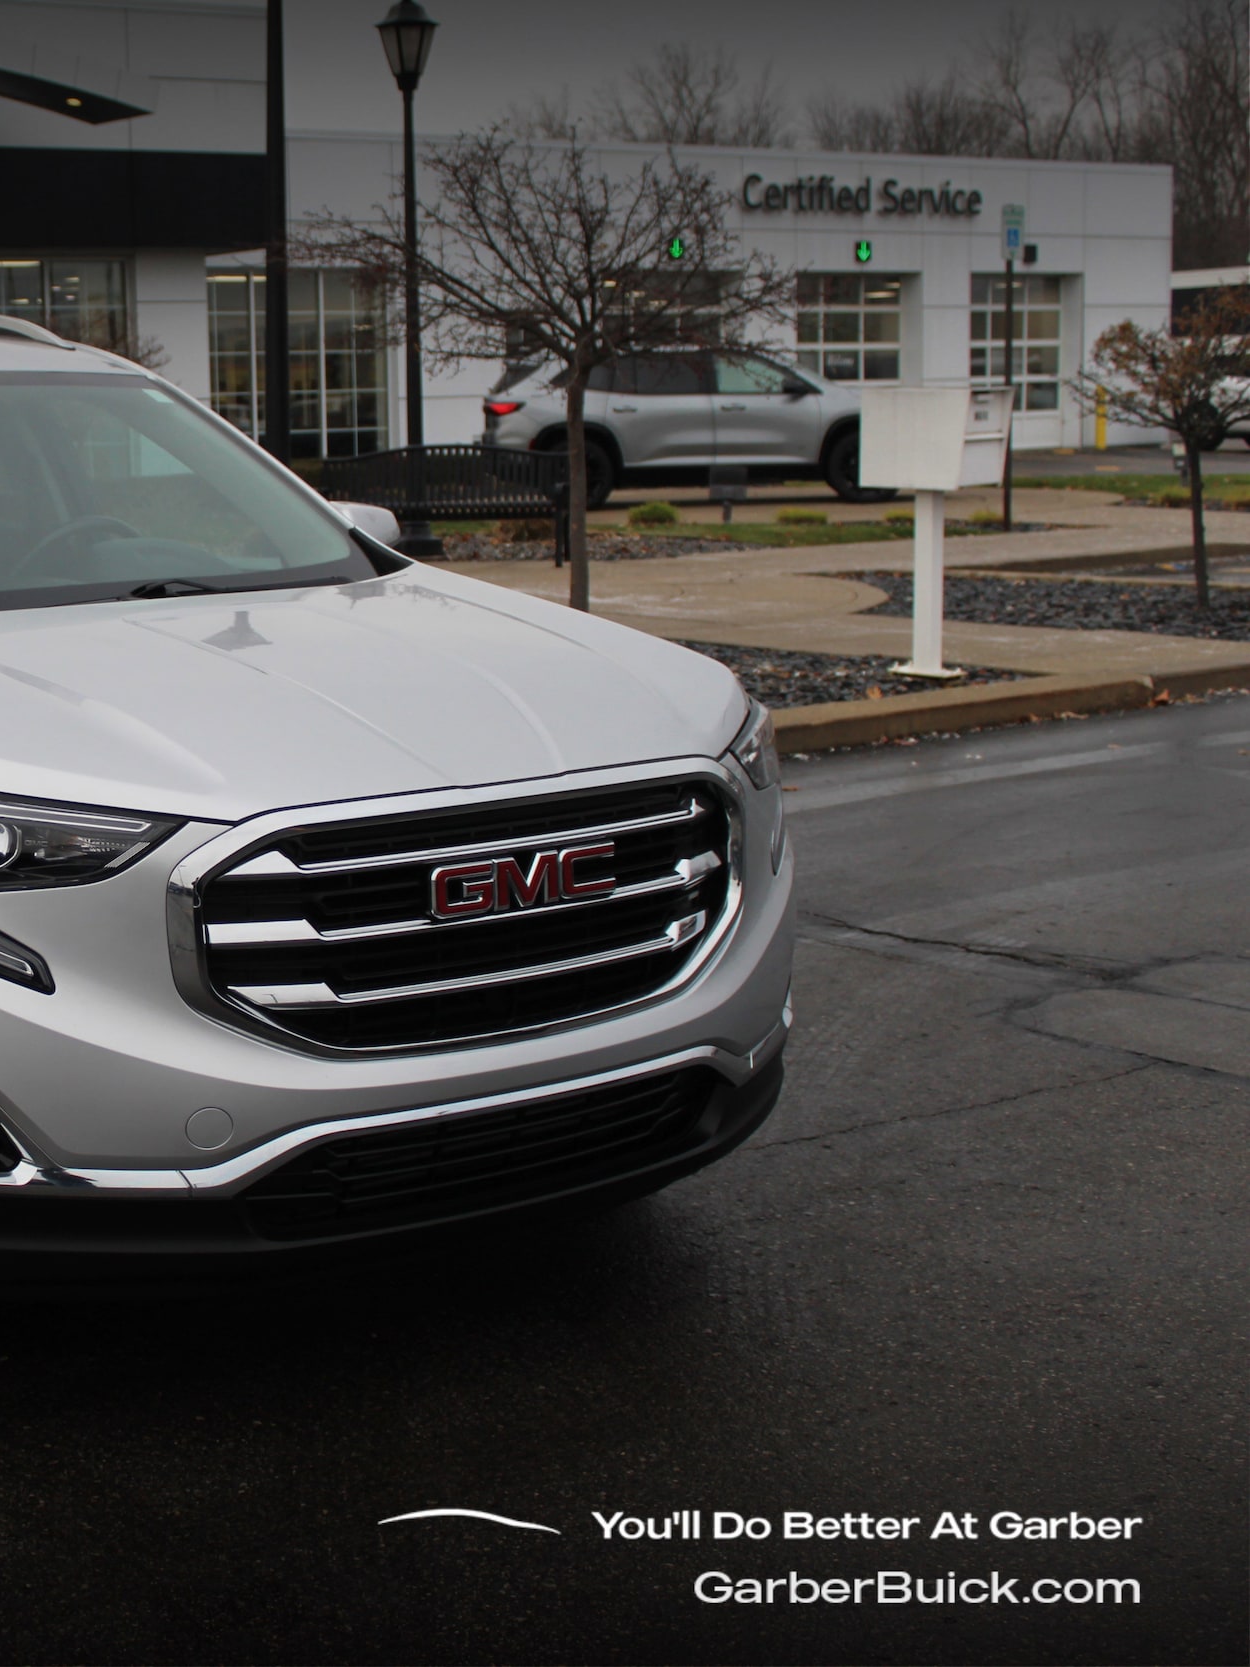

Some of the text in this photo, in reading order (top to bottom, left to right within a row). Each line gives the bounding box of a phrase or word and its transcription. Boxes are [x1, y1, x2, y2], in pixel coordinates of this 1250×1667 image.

[742, 173, 871, 213] Certified
[878, 179, 982, 216] Service
[431, 842, 616, 919] GMC
